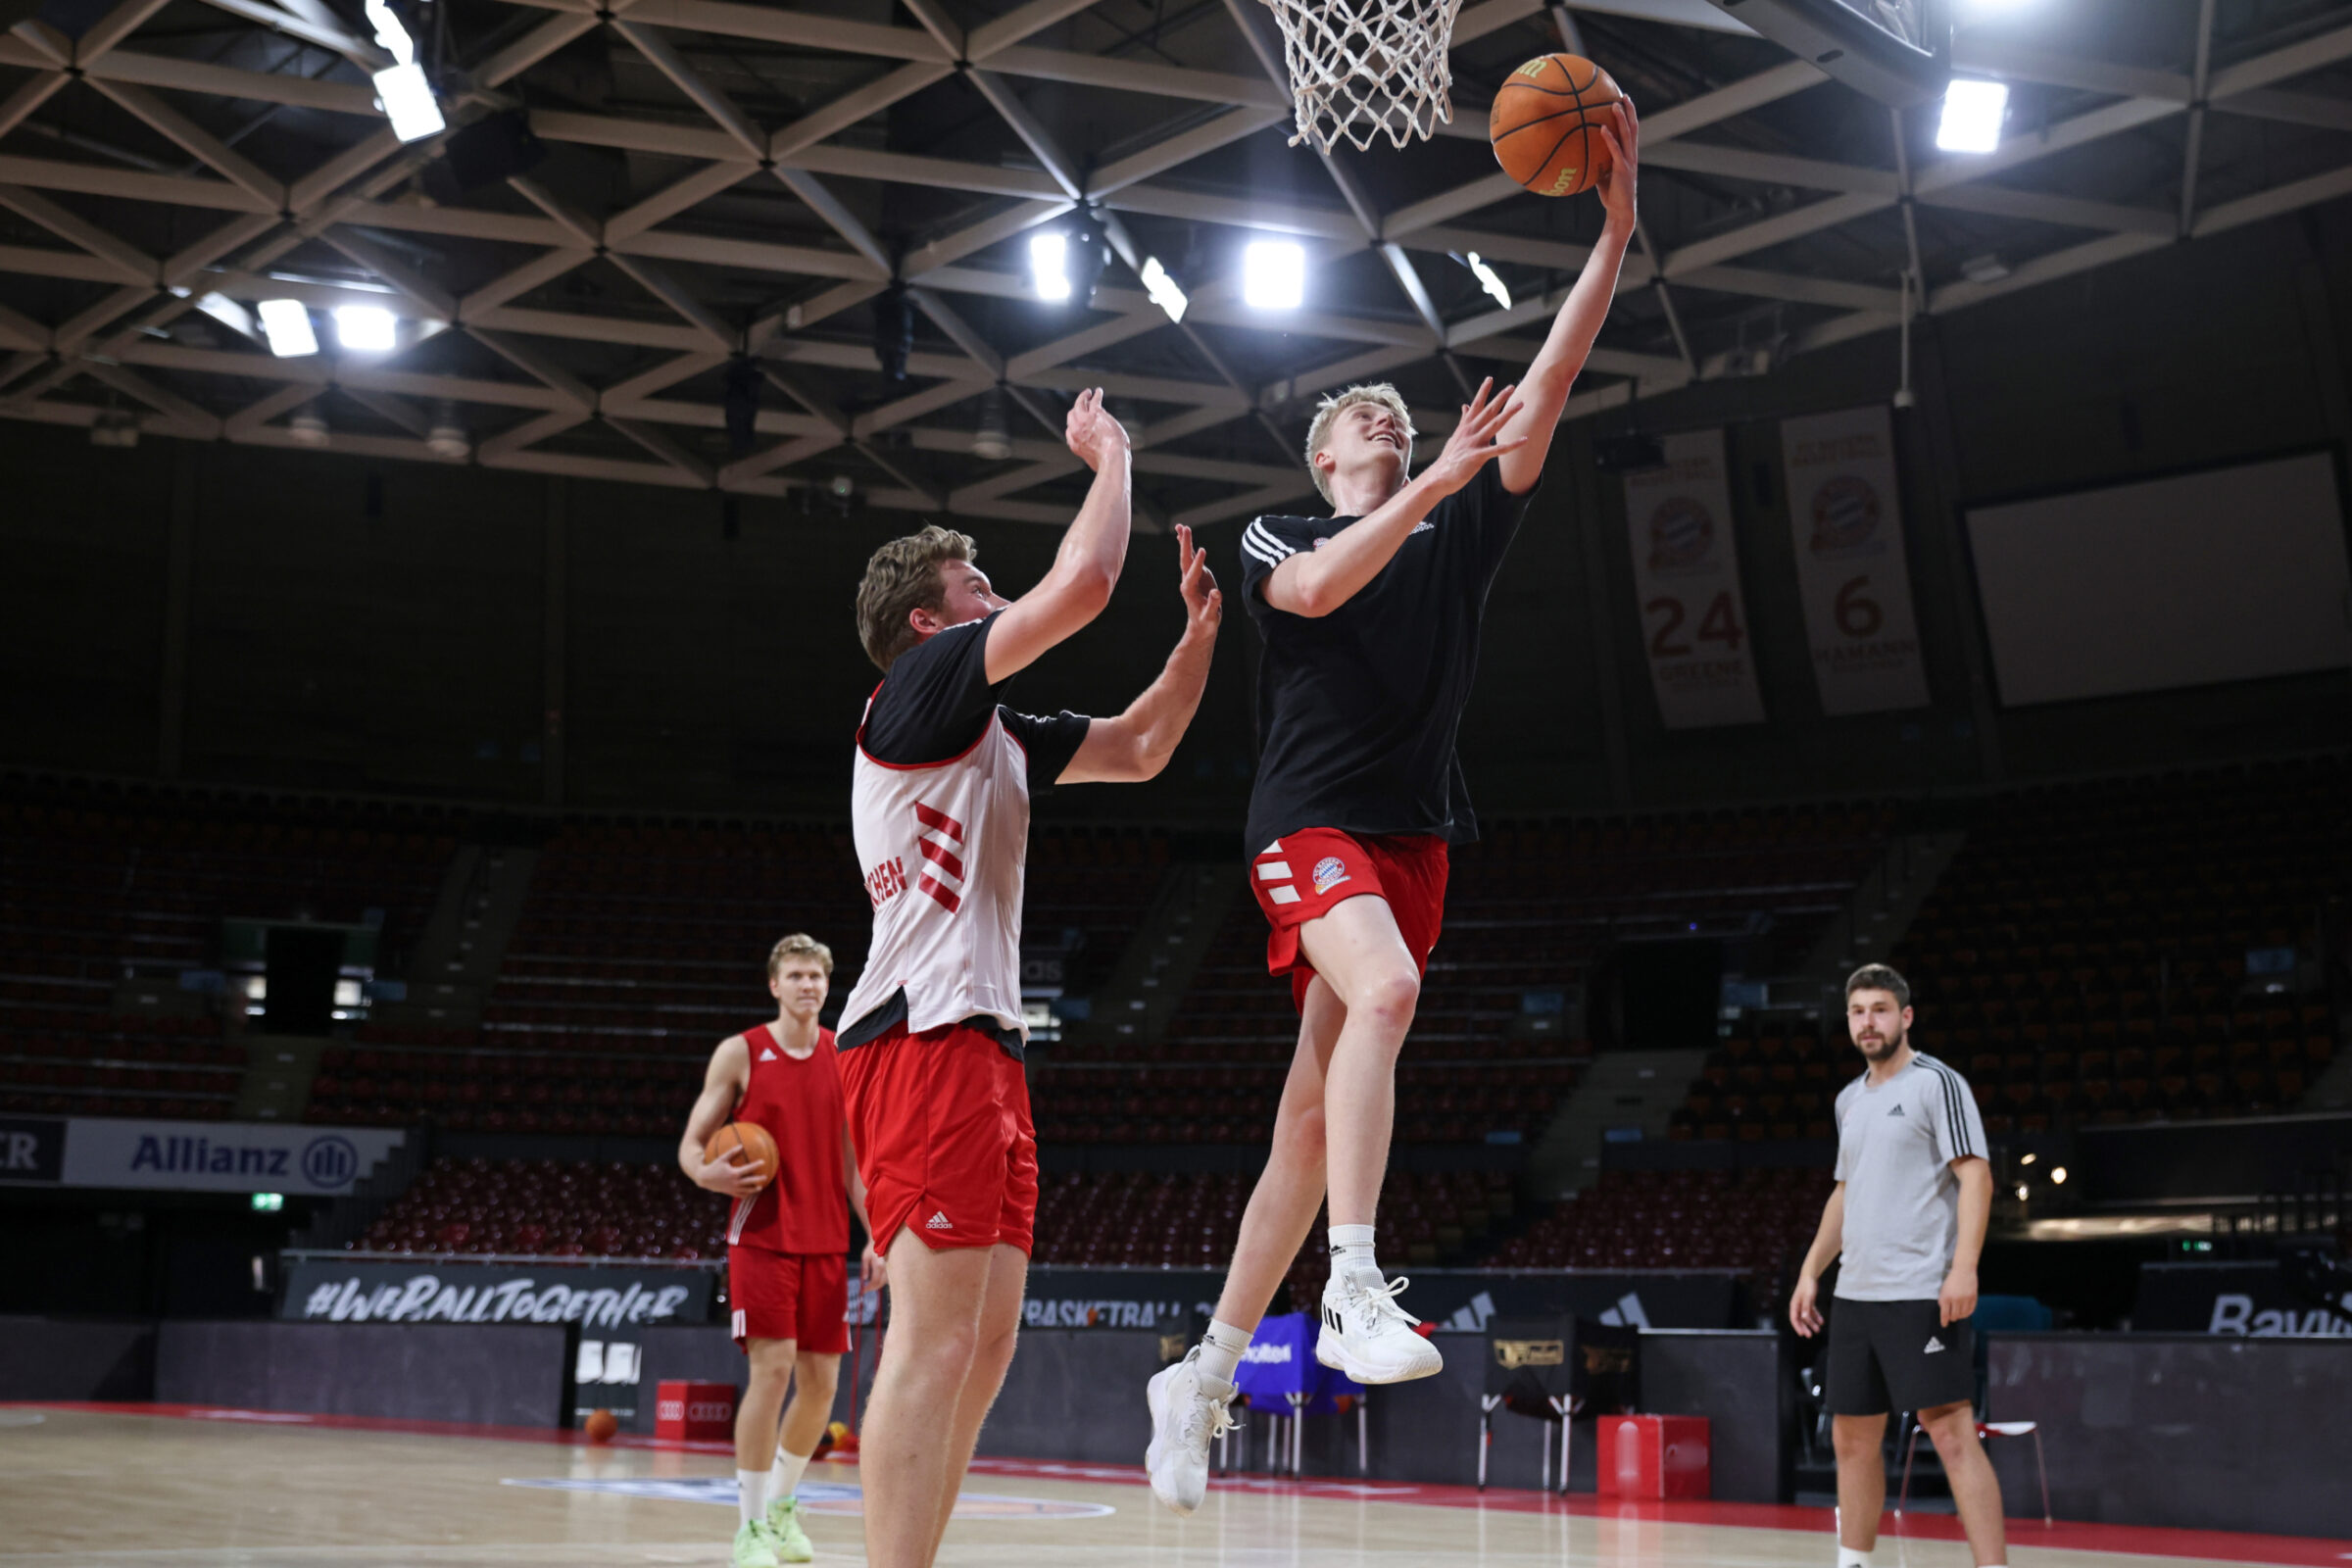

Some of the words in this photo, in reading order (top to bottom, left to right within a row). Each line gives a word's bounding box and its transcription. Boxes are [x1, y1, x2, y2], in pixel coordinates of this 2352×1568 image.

[1645, 590, 1743, 658] 24
[1835, 575, 1883, 638] 6
[0, 1131, 38, 1170] R
[130, 1135, 291, 1176] Allianz
